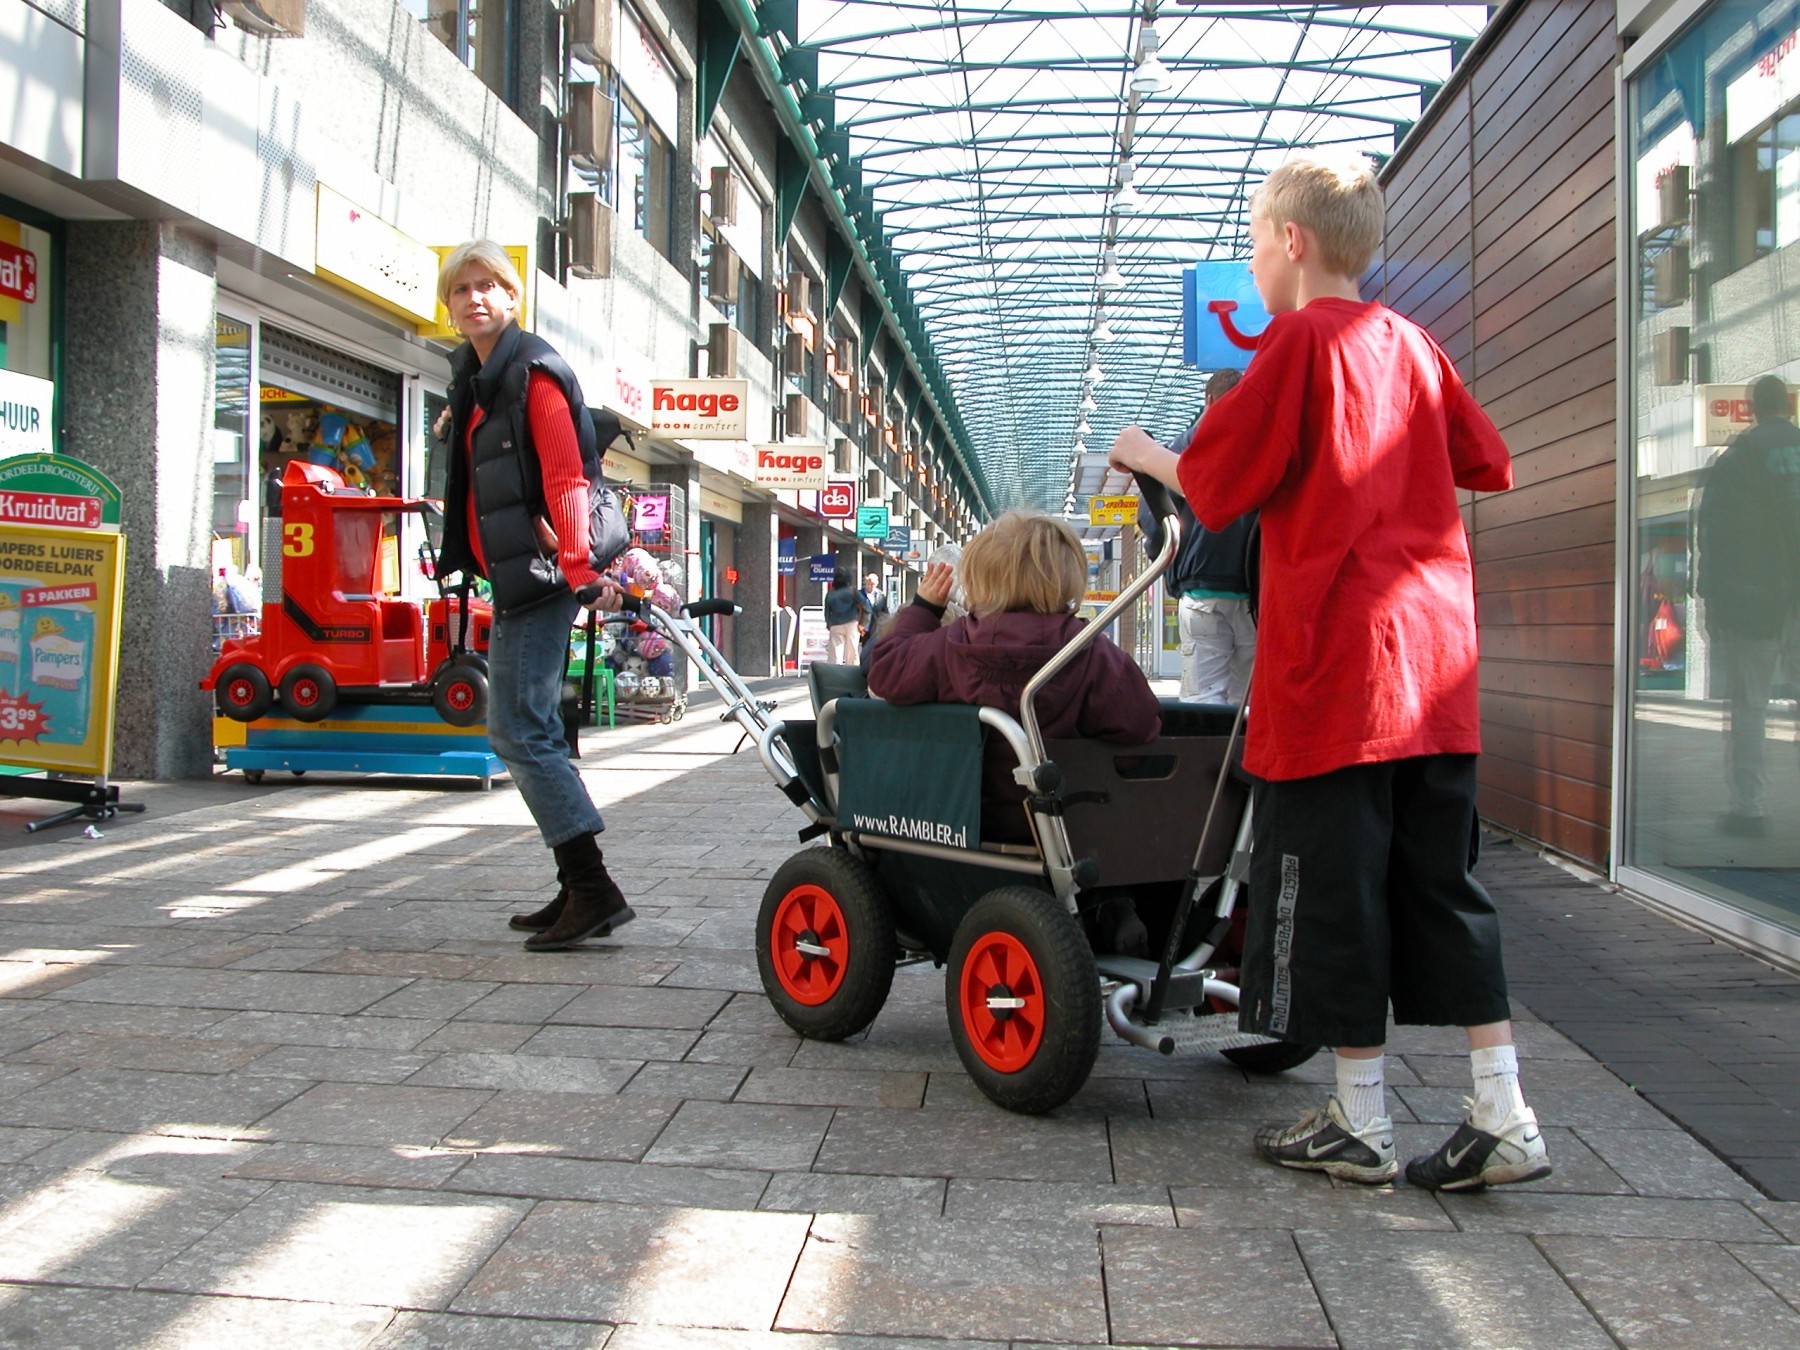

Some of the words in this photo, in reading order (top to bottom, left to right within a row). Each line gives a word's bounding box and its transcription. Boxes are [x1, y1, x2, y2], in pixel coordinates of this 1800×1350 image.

[653, 388, 739, 417] hage
[758, 451, 822, 473] hage
[823, 488, 848, 506] da
[0, 494, 86, 522] Kruidvat
[283, 523, 315, 557] 3
[51, 546, 104, 562] LUIERS
[0, 557, 94, 576] ORDEELPAK
[27, 592, 36, 603] 2
[39, 586, 91, 603] PAKKEN
[34, 647, 81, 668] Pampers
[853, 813, 967, 849] www.RAMBLER.nl
